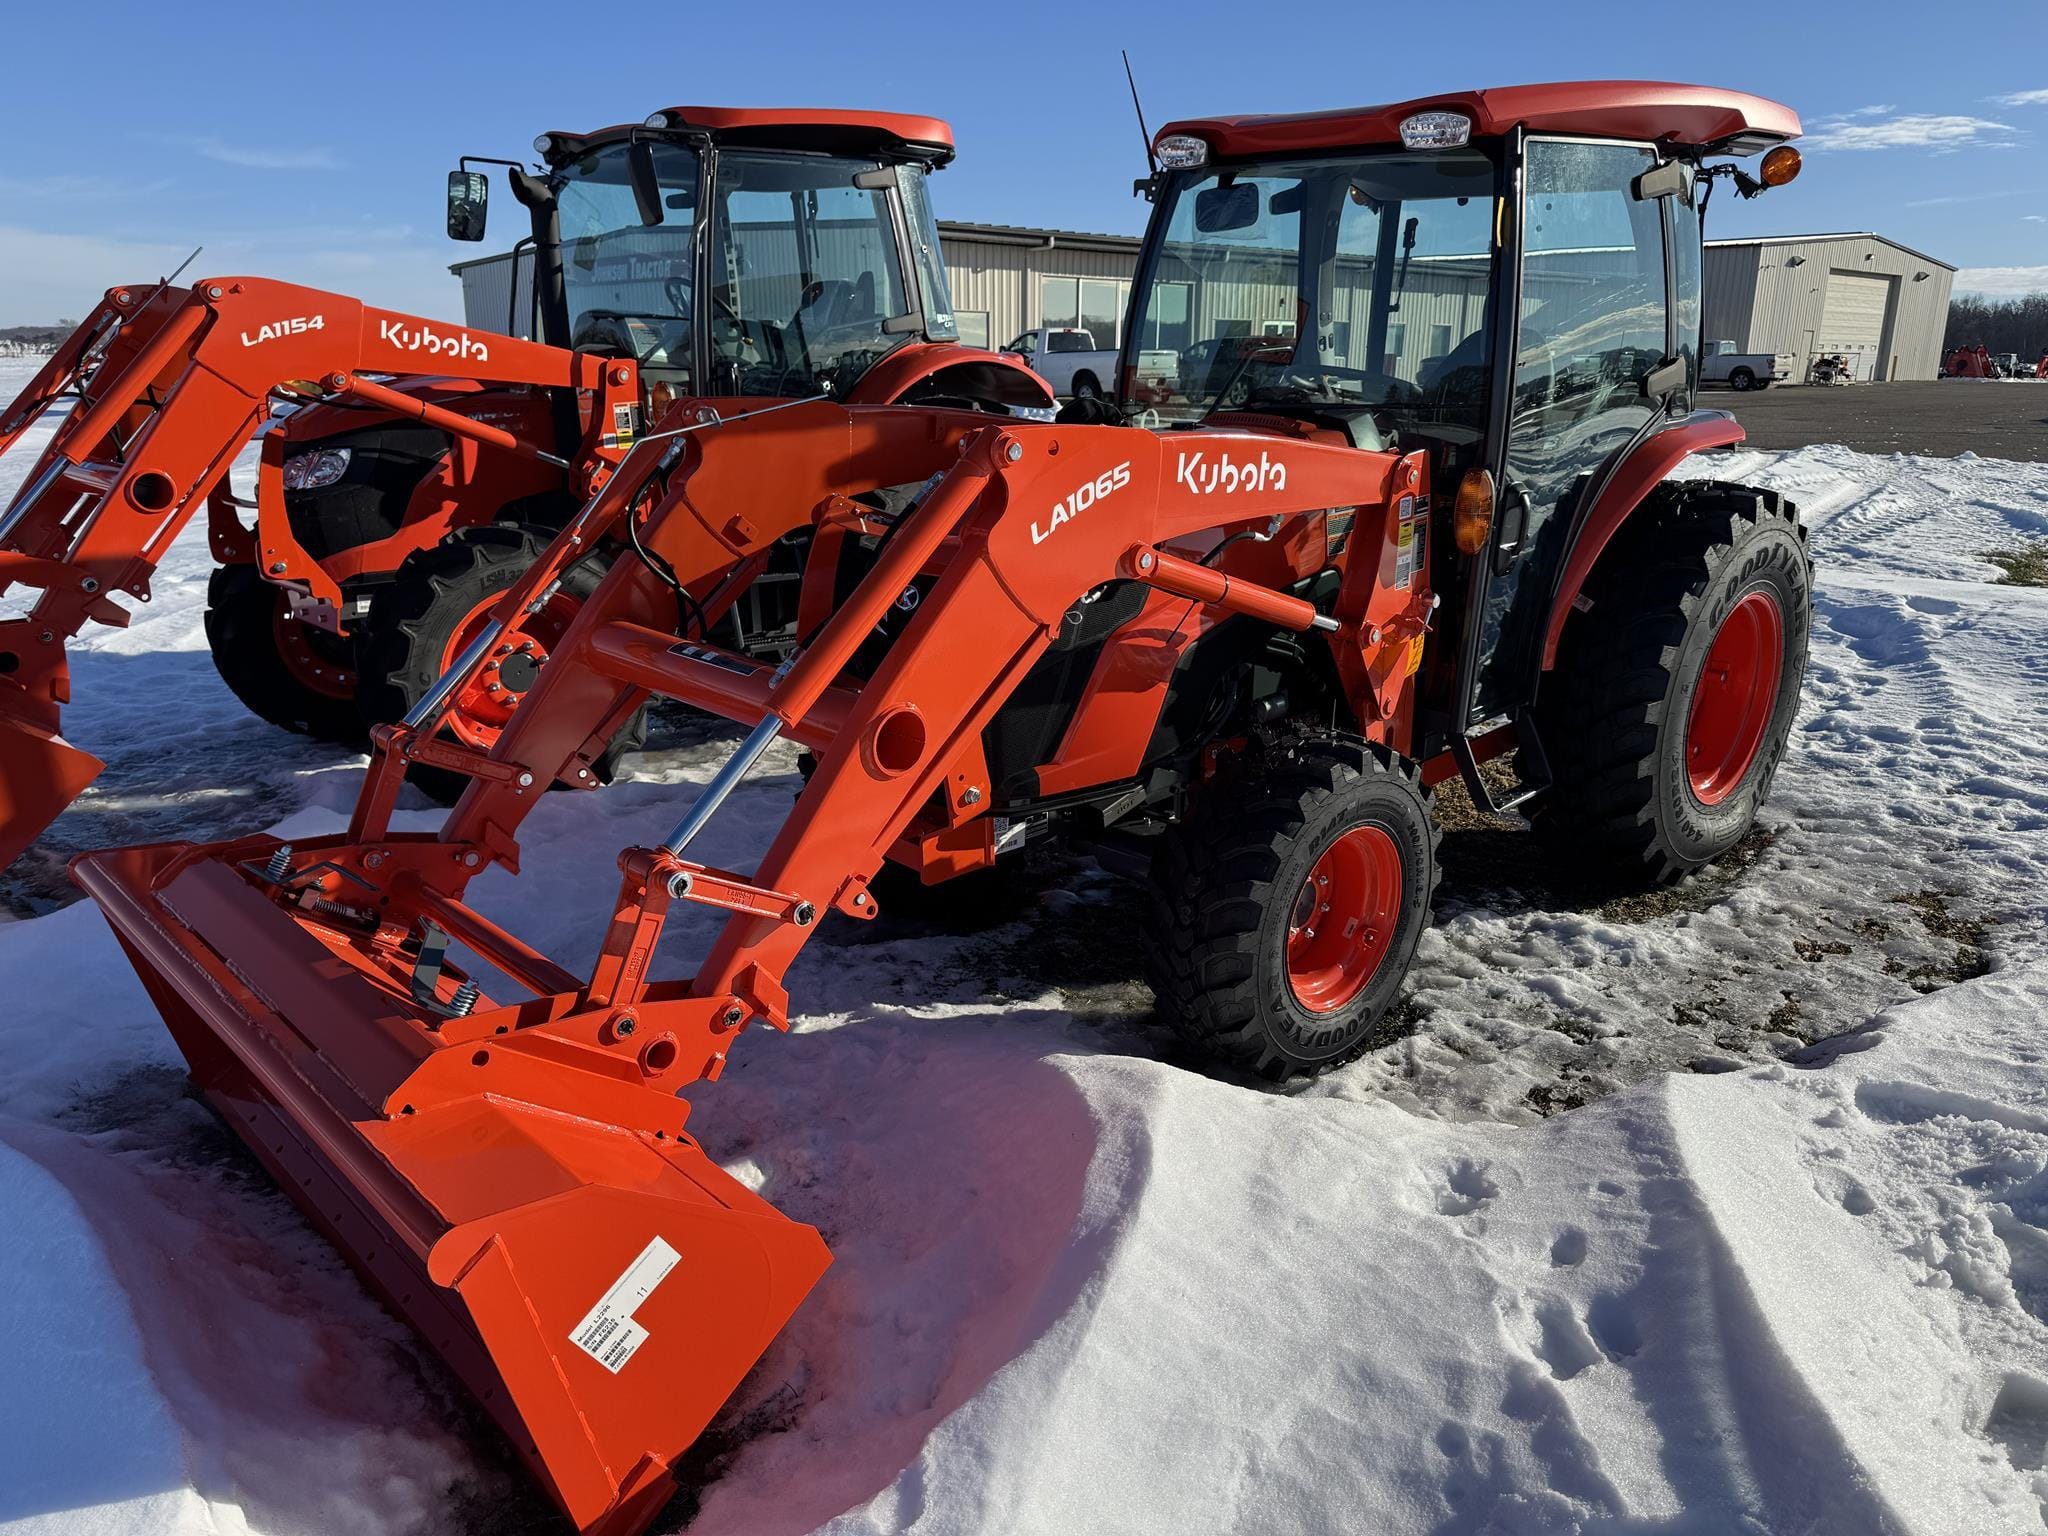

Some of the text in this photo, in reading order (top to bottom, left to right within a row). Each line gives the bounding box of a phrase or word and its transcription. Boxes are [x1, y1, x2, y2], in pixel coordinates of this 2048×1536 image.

[241, 314, 325, 347] LA1154
[380, 319, 489, 362] Kubota
[1176, 451, 1287, 494] Kubota
[1030, 461, 1131, 545] LA1065
[1709, 542, 1808, 638] GOODYEAR
[1266, 972, 1372, 1050] GOODYEAR
[636, 1286, 648, 1298] 11
[577, 1324, 594, 1343] Model
